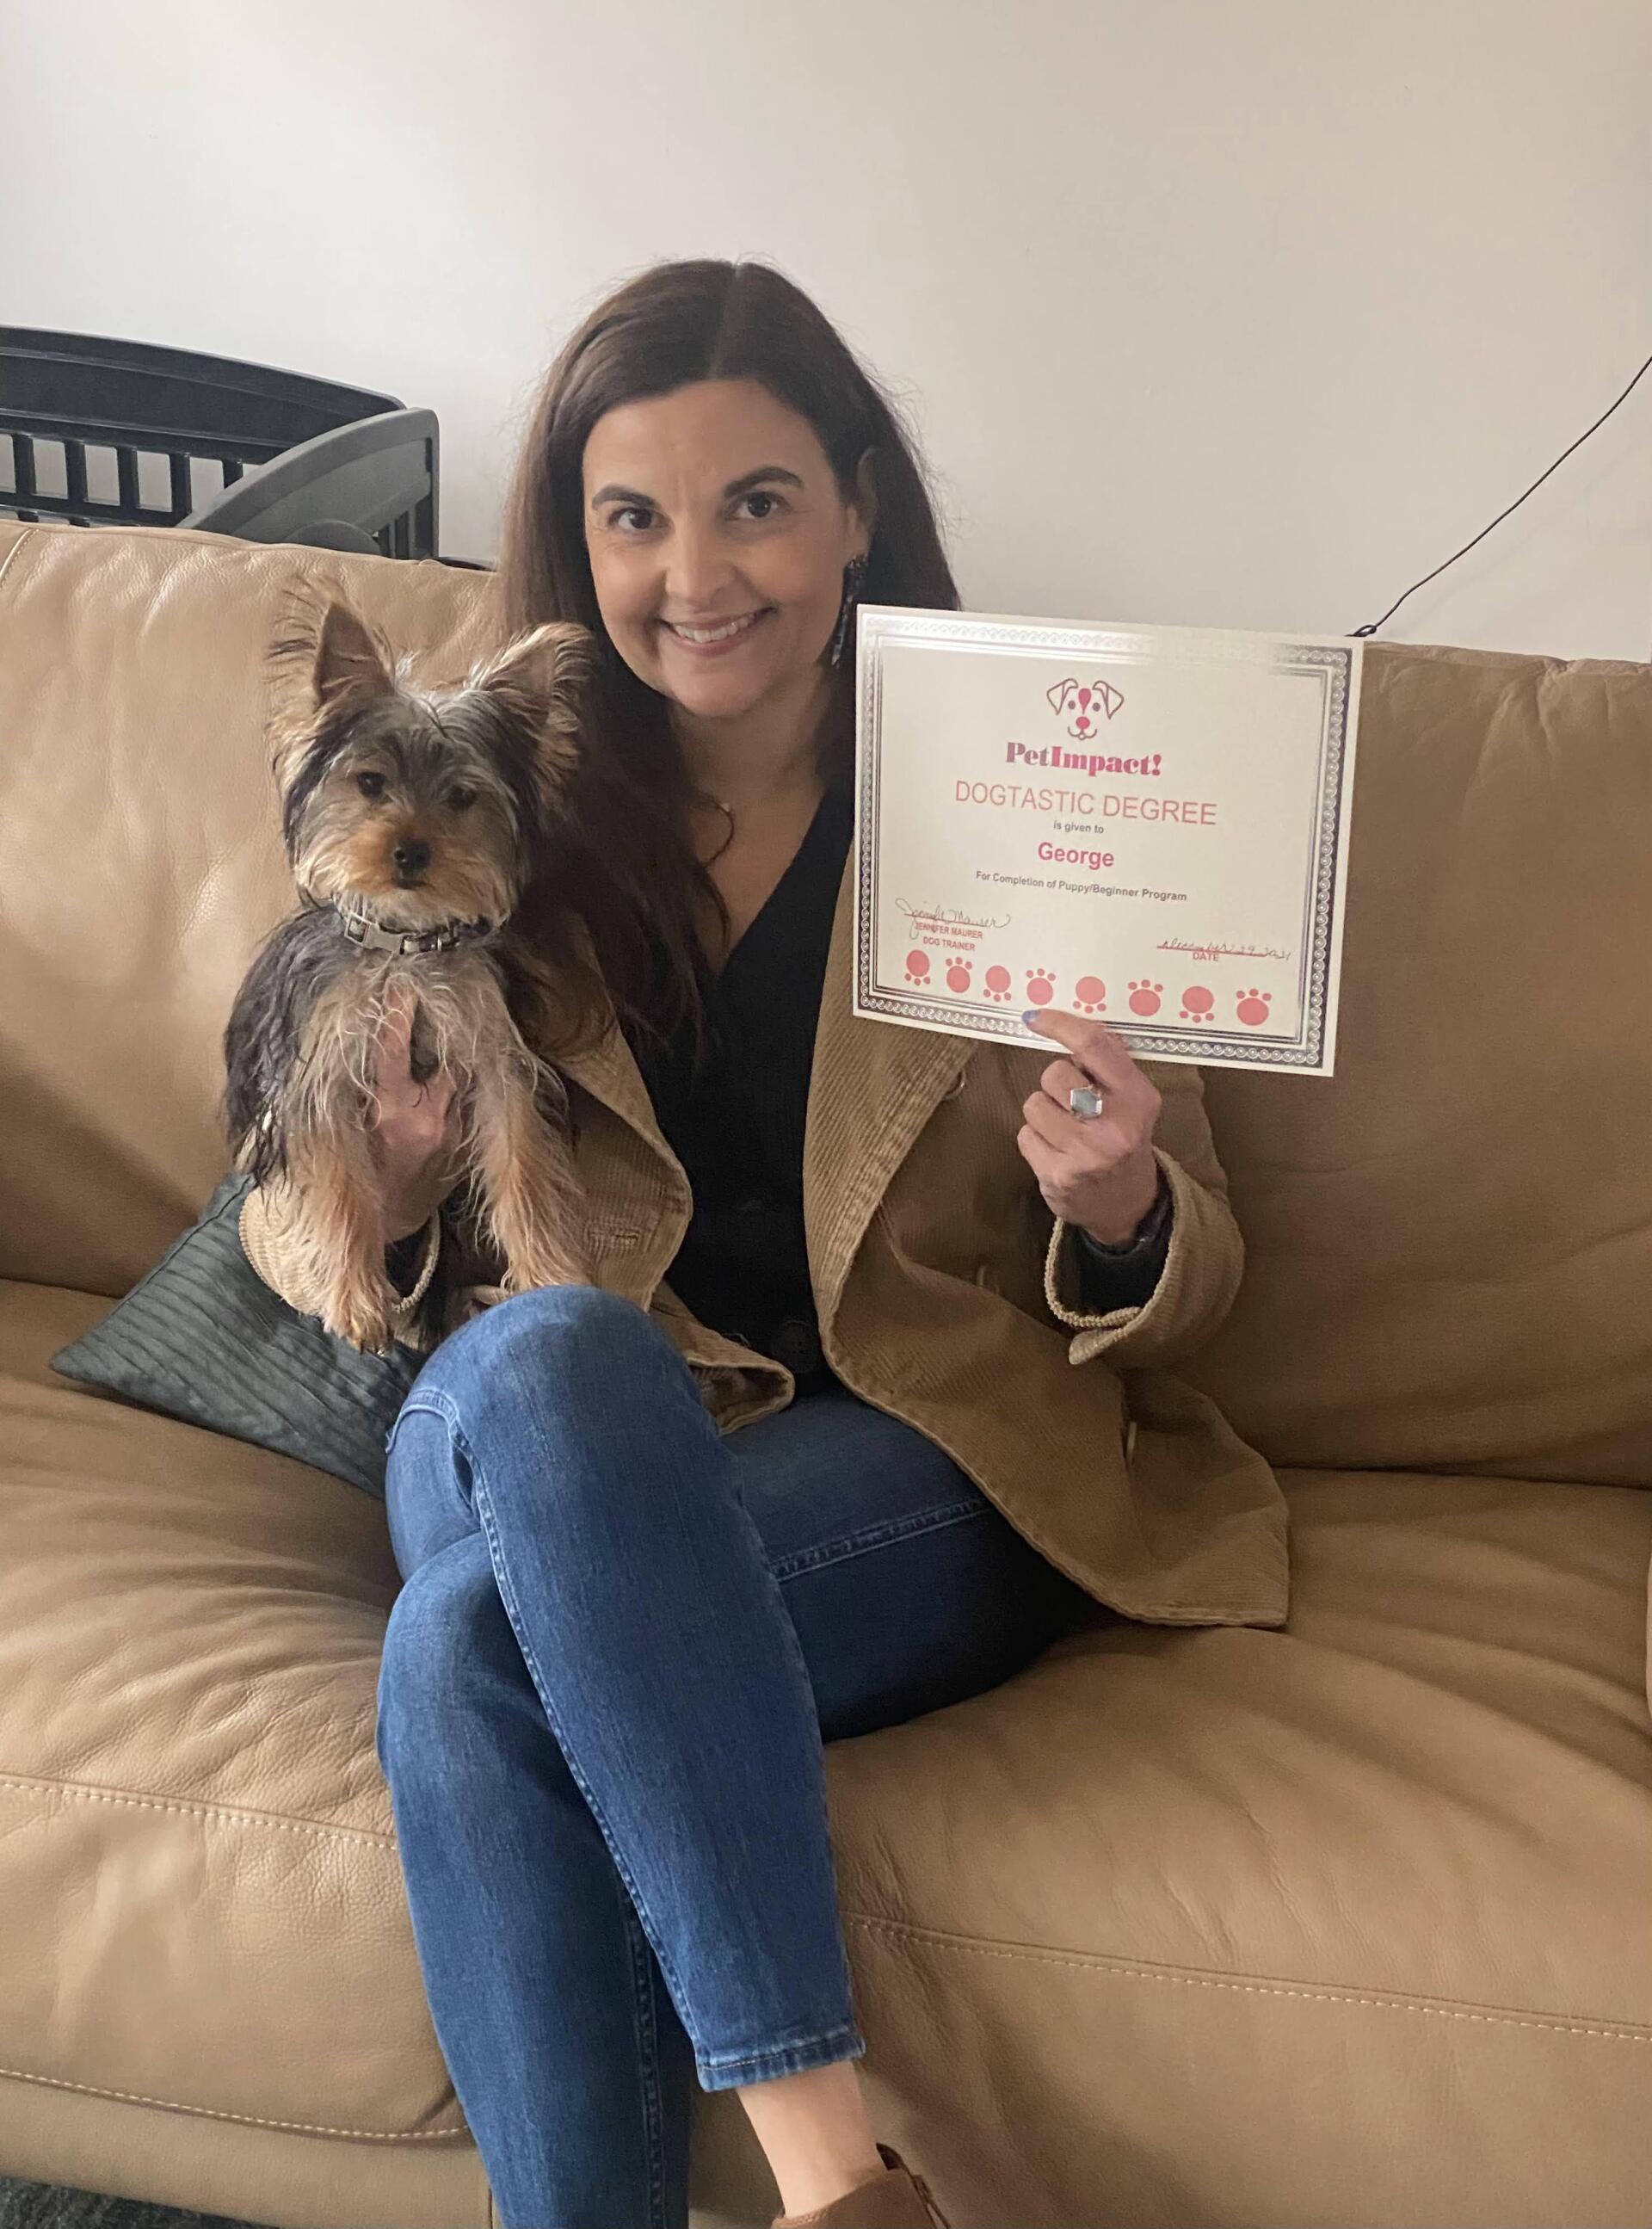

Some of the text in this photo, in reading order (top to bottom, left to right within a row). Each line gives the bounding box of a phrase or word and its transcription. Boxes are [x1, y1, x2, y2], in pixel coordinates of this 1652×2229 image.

[1005, 742, 1162, 777] PetImpact!
[955, 780, 1217, 825] DOGTASTIC DEGREE
[1053, 820, 1105, 833] is given to
[1038, 842, 1114, 870] George
[976, 871, 1187, 902] For Completion of Puppy/Beginner Program
[915, 922, 983, 939] JENNIFER MAURER
[922, 935, 977, 951] DOG TRAINER
[1192, 951, 1219, 962] DATE
